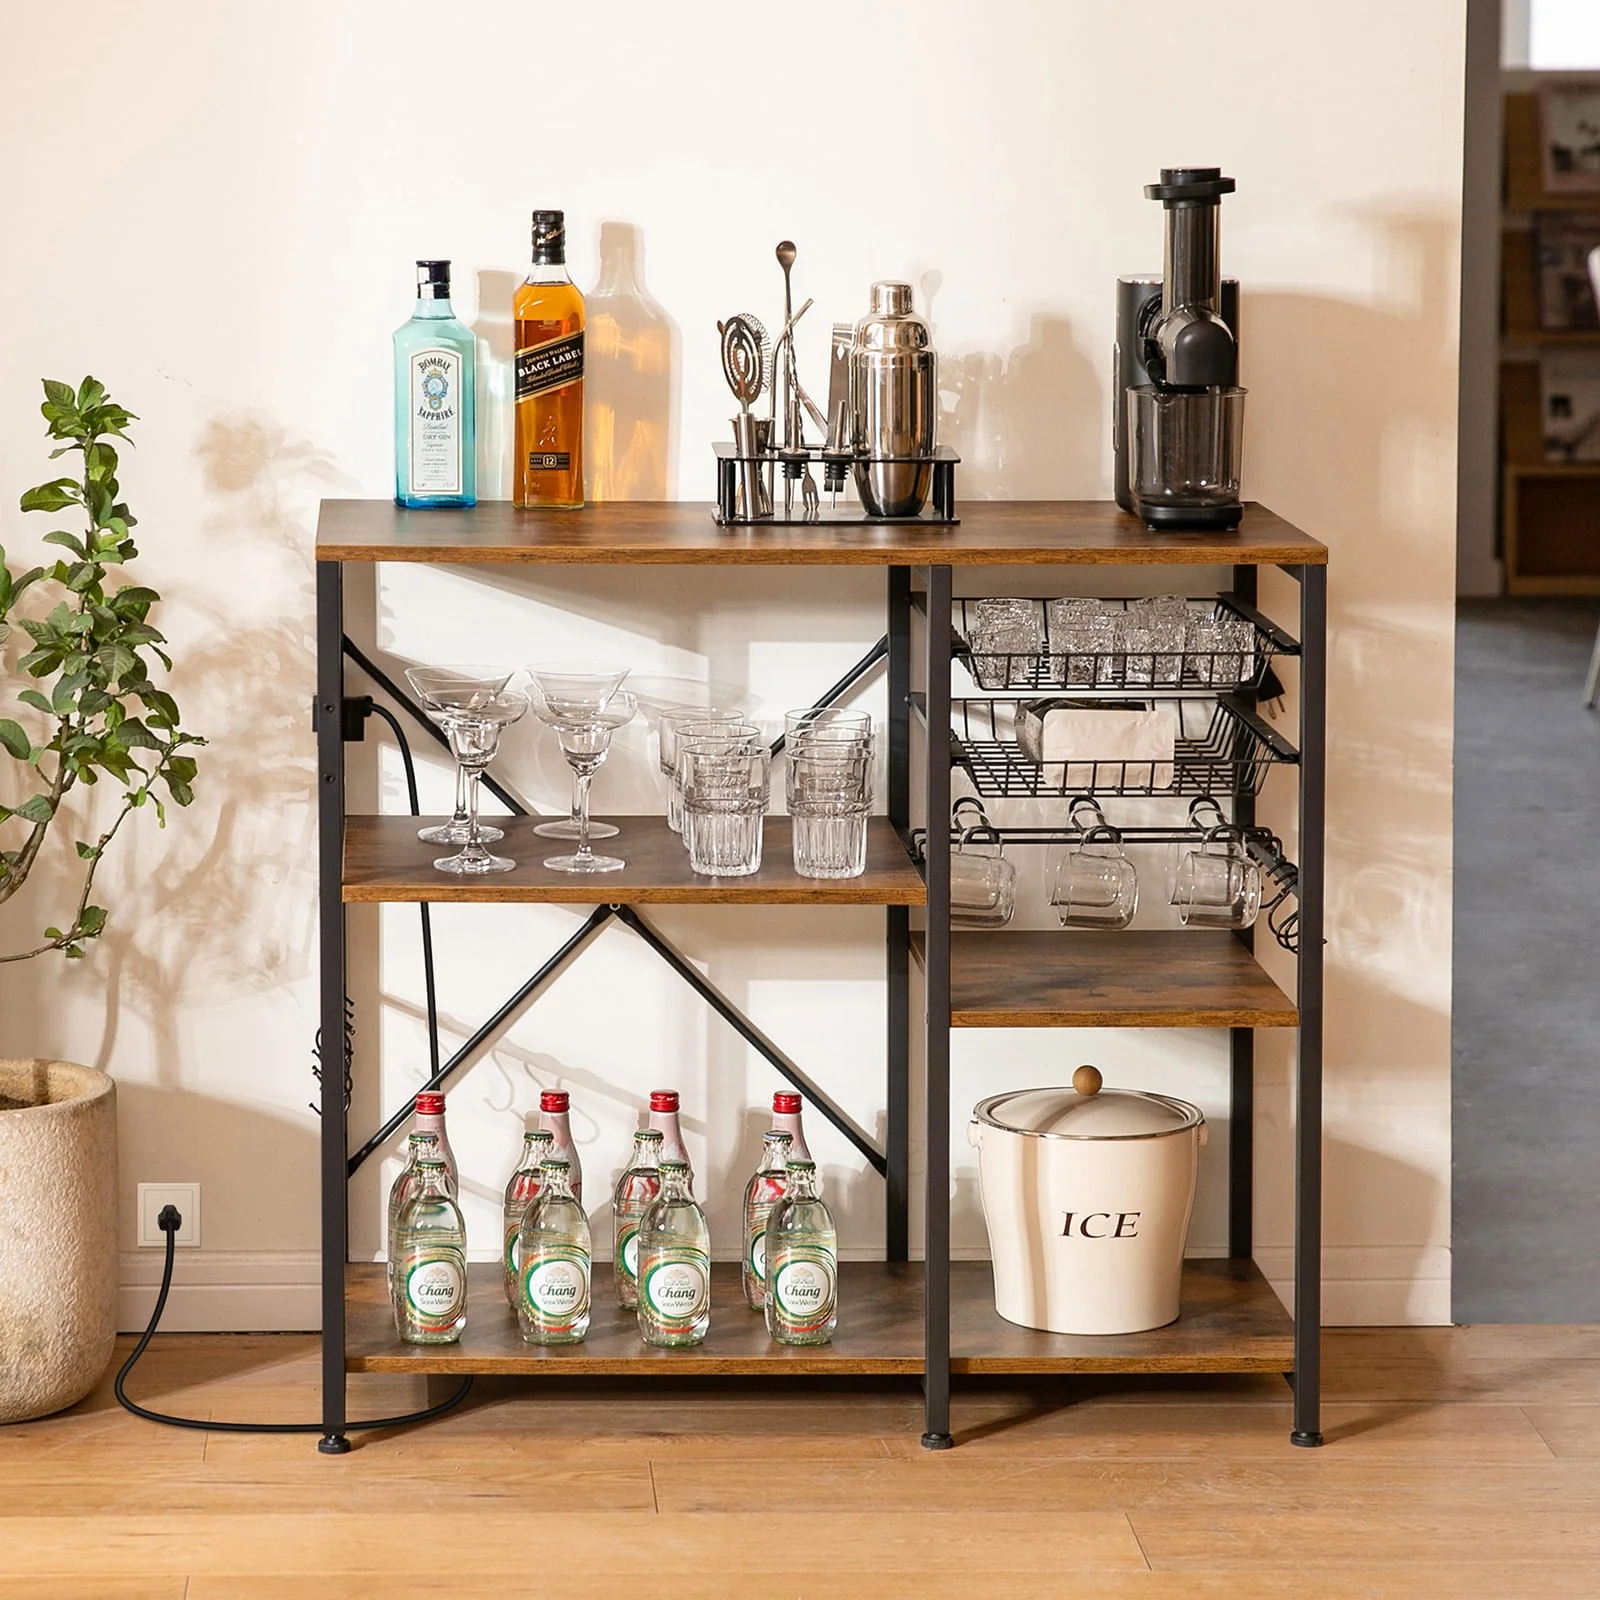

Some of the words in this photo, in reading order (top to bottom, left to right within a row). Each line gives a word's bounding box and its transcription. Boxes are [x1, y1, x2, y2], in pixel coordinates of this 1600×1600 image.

[417, 357, 452, 374] BOMBAY
[518, 360, 551, 378] BLACK
[552, 349, 583, 365] LABEL
[417, 405, 454, 421] SAPPHIRE
[546, 457, 555, 465] 12
[1058, 1211, 1141, 1238] ICE
[418, 1284, 454, 1298] Chang
[539, 1284, 576, 1298] Chang
[658, 1286, 696, 1300] Chang
[784, 1284, 821, 1299] Chang
